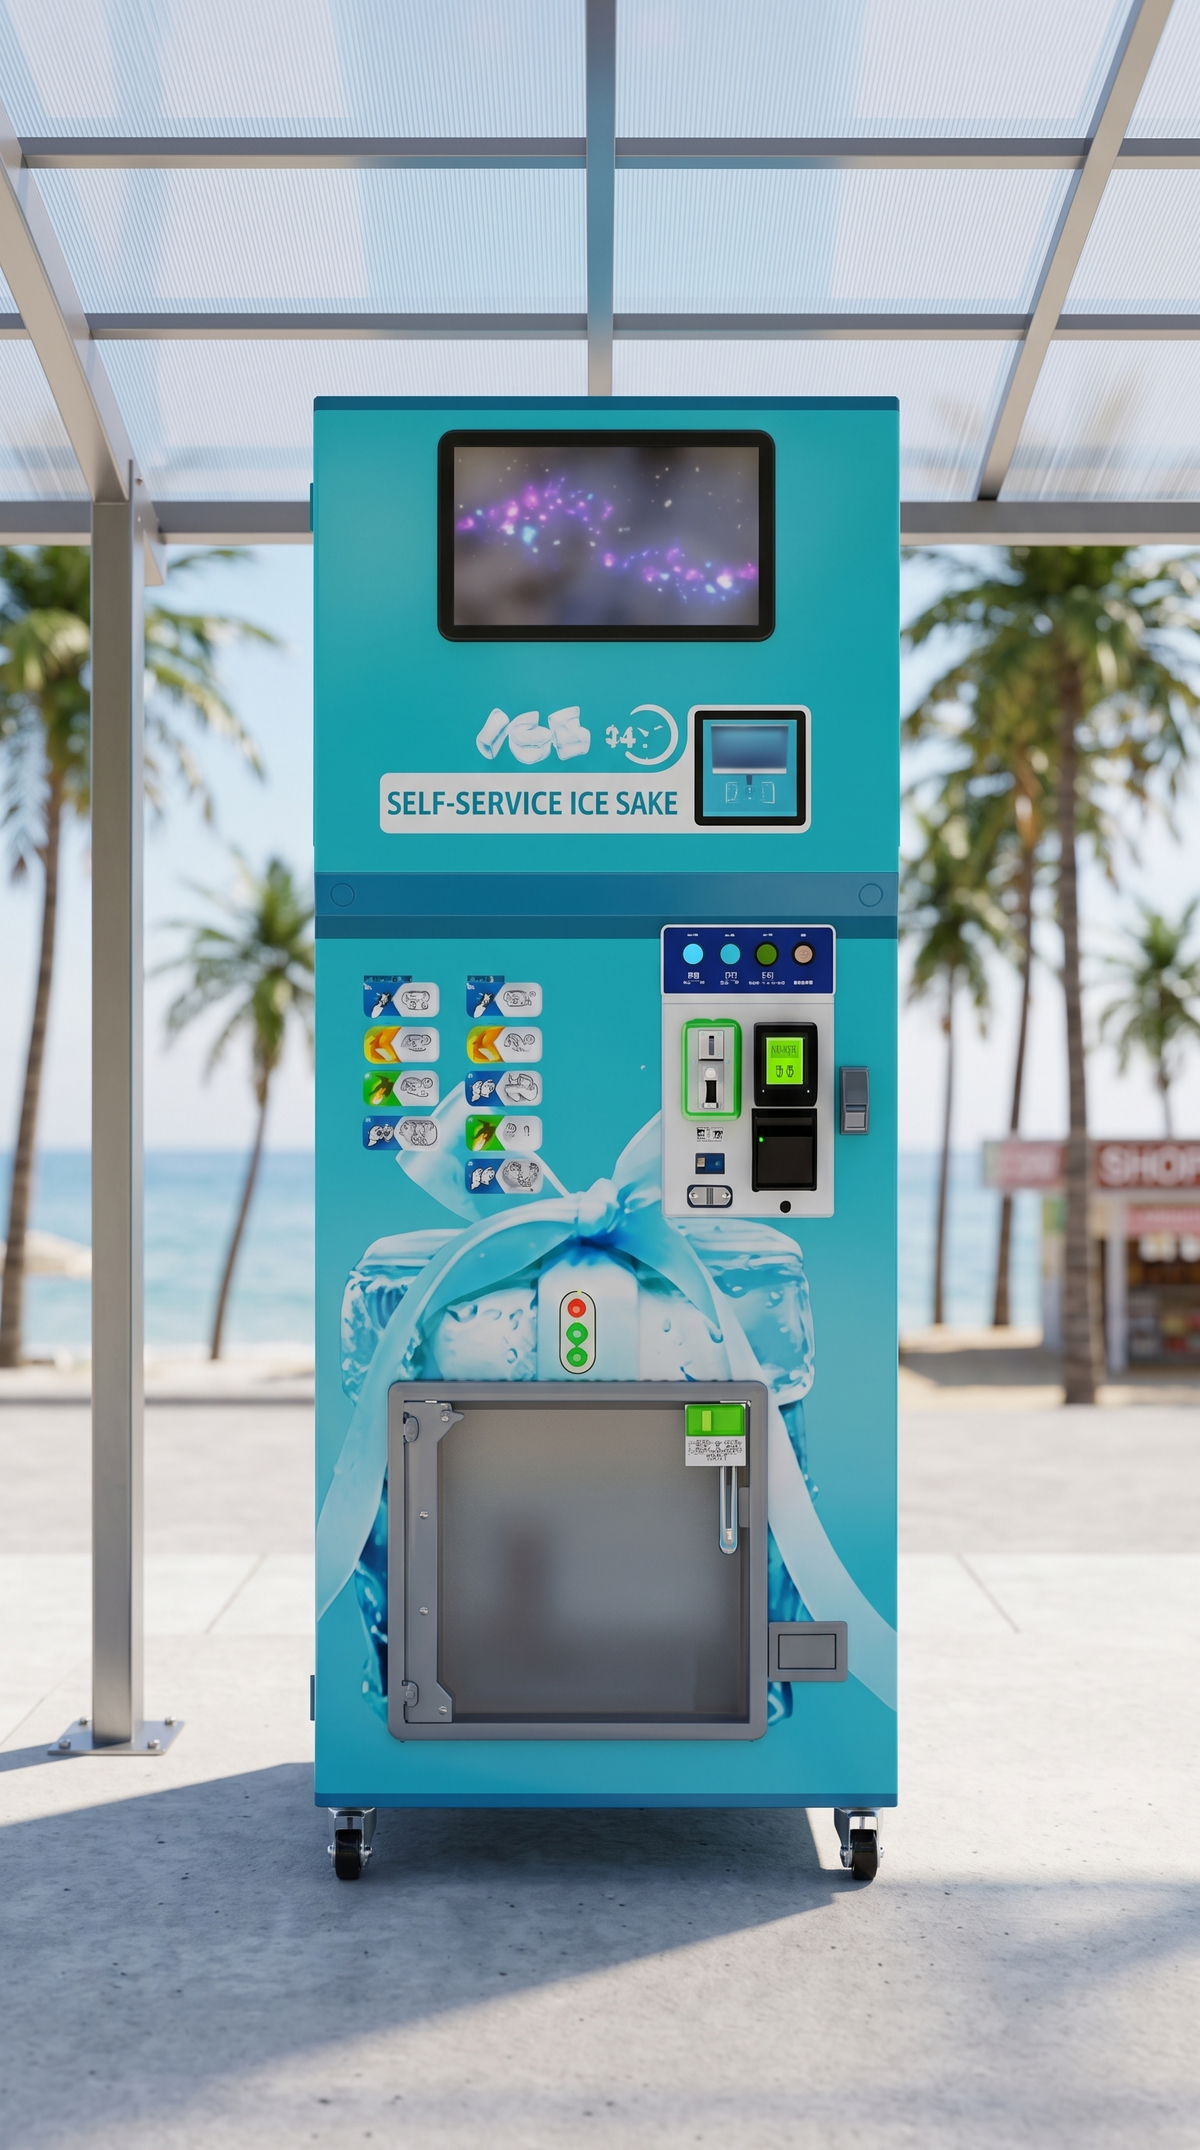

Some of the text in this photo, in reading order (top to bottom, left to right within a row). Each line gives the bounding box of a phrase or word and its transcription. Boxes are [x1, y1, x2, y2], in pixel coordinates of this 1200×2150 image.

[387, 790, 678, 816] SELF-SERVICE ICE SAKE
